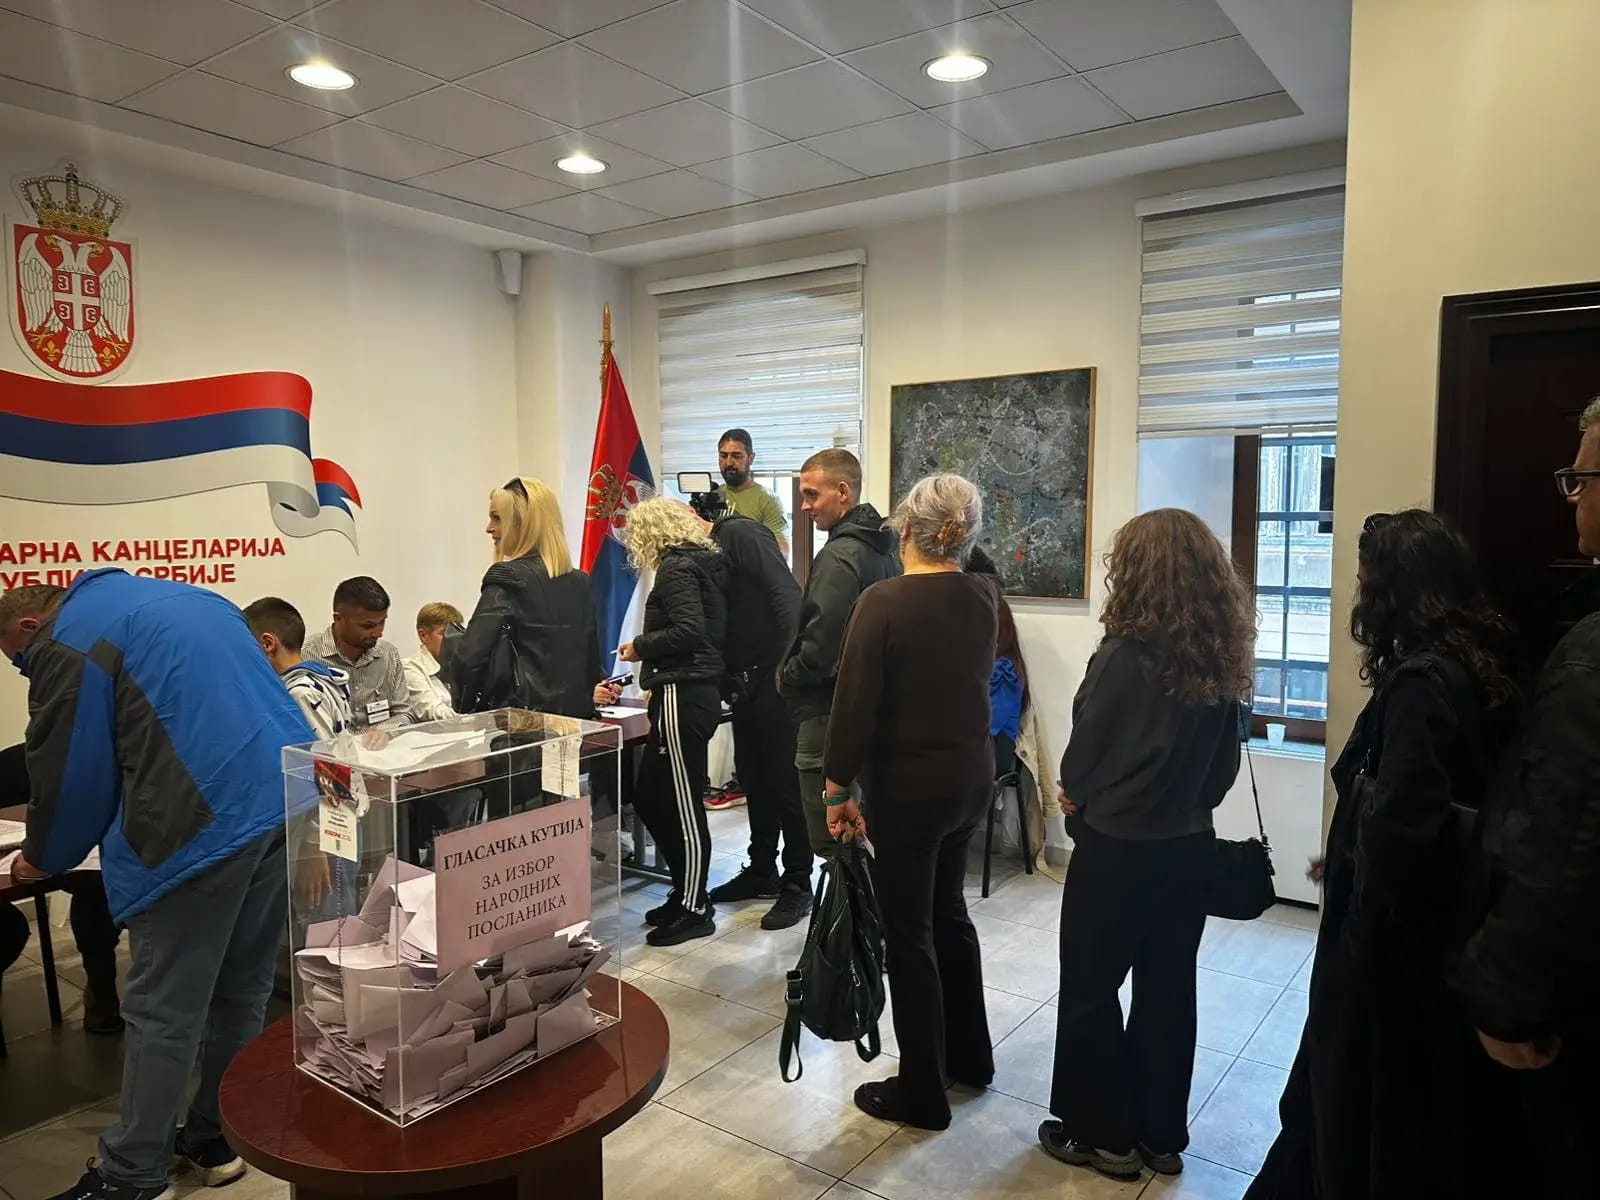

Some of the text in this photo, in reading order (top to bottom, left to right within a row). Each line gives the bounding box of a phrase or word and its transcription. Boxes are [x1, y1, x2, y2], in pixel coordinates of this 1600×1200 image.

[0, 537, 286, 565] АРНА КАНЦЕЛАРИЈА
[443, 817, 585, 871] ГЛАСАЧКА КУТИЈА
[482, 855, 555, 890] ЗА ИЗБОР
[475, 873, 561, 916] НАРОДНИХ
[467, 893, 567, 940] ПОСЛАНИКА
